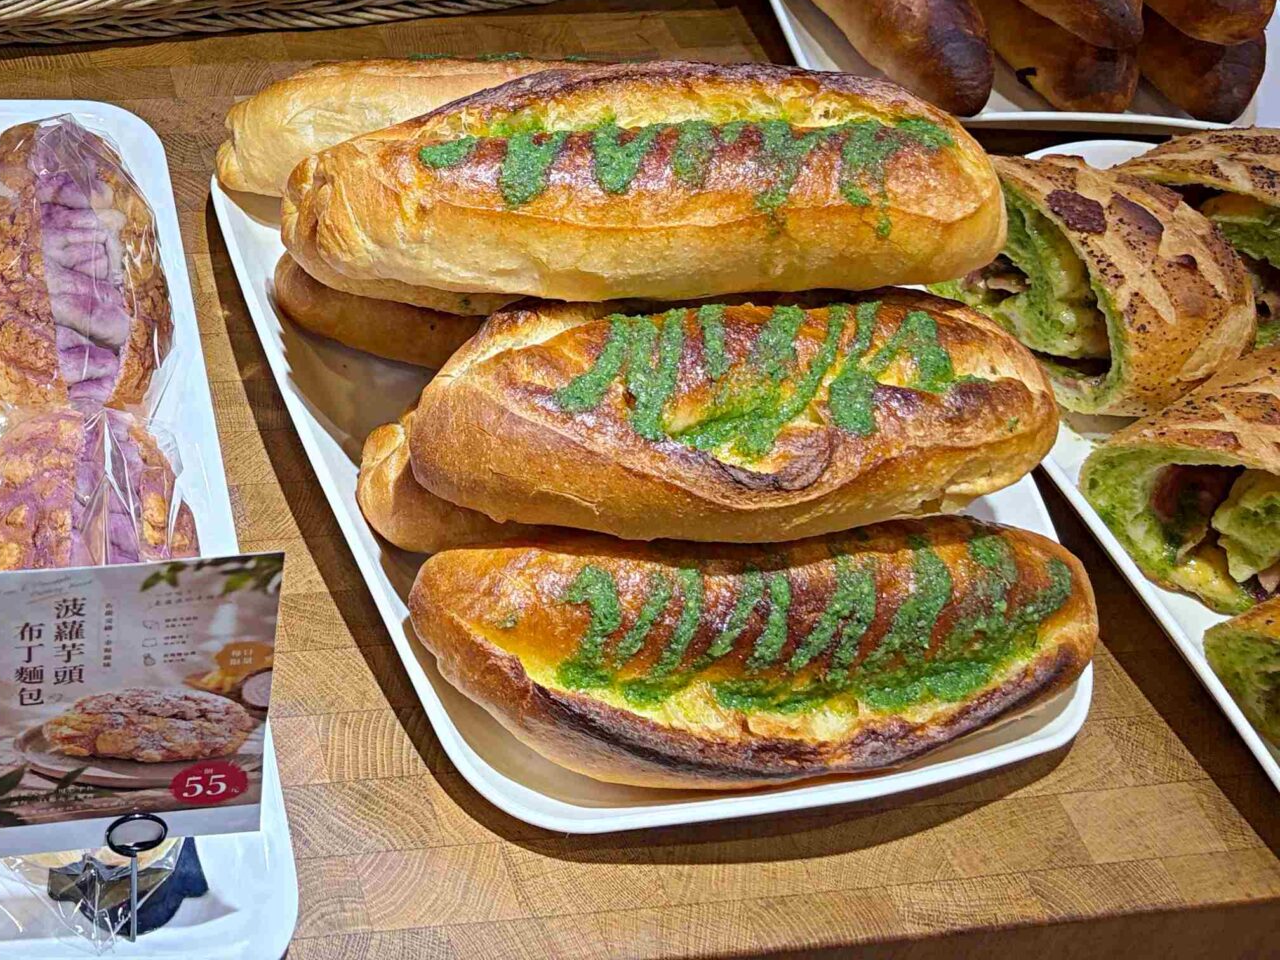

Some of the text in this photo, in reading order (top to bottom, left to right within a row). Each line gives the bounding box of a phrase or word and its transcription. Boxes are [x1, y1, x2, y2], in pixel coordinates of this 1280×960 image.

[13, 622, 46, 705] 布丁麵包
[53, 597, 87, 685] 菠蘿芋頭
[182, 774, 227, 798] 55
